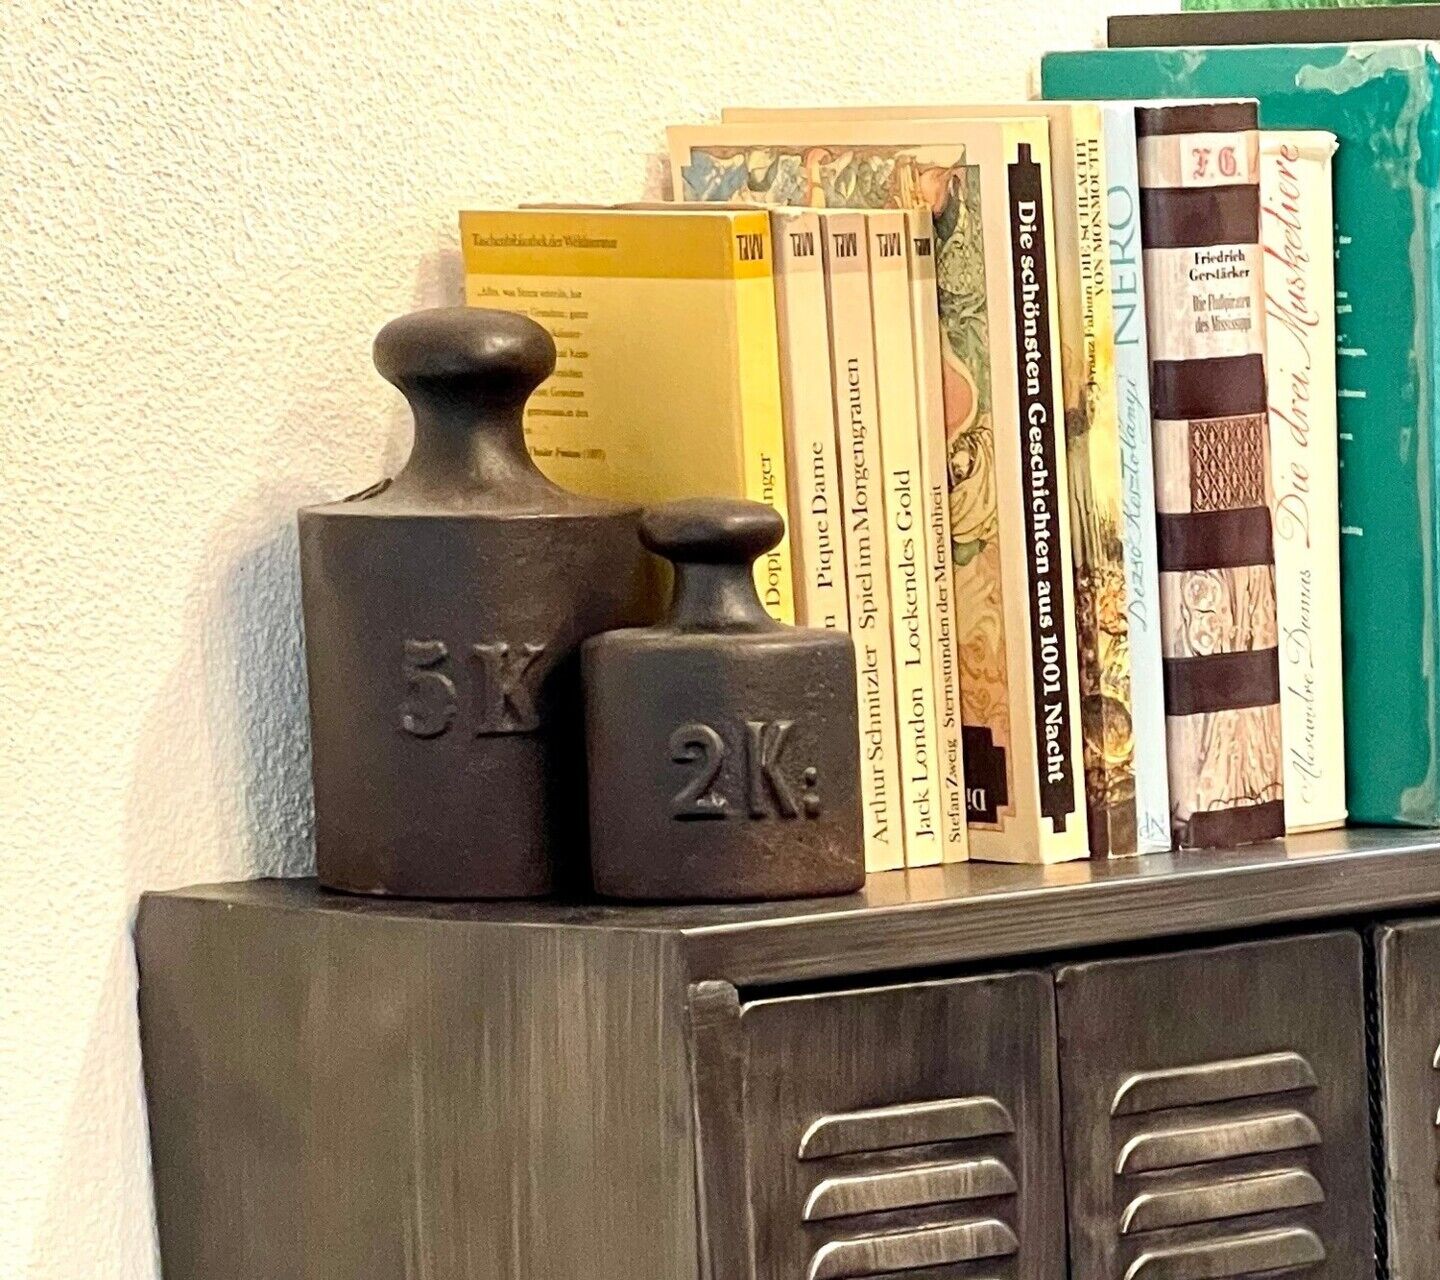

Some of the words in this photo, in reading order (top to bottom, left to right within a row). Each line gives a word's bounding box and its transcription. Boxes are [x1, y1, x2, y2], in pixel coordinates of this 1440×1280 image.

[1017, 200, 1038, 250] Die
[1076, 139, 1090, 239] SCHLACHT
[1088, 138, 1103, 251] MONMOUTH
[1092, 258, 1104, 296] VON
[1106, 185, 1140, 346] NERO
[1194, 250, 1246, 265] Friedrich
[1261, 143, 1320, 370] Musketiere
[1020, 256, 1042, 396] schönsten
[847, 357, 871, 533] Morgengrauen
[1268, 368, 1311, 447] drei
[812, 441, 829, 514] Dame
[893, 469, 914, 532] Gold
[1028, 403, 1052, 574] Geschichten
[1275, 462, 1311, 549] Die
[816, 519, 836, 588] Pique
[854, 535, 872, 568] im
[931, 484, 947, 584] Menschheit
[855, 572, 878, 630] Spiel
[898, 537, 921, 667] Lockendes
[935, 586, 949, 614] der
[1037, 582, 1054, 629] aus
[401, 640, 459, 738] 5
[862, 644, 884, 762] Schnitzler
[937, 615, 956, 729] Sternstunden
[1041, 634, 1061, 696] 1001
[670, 723, 727, 819] 2
[908, 686, 930, 783] London
[945, 737, 958, 789] Zweig
[1045, 703, 1066, 784] Nacht
[869, 764, 889, 845] Arthur
[913, 788, 936, 841] Jack
[946, 795, 962, 844] Stefan
